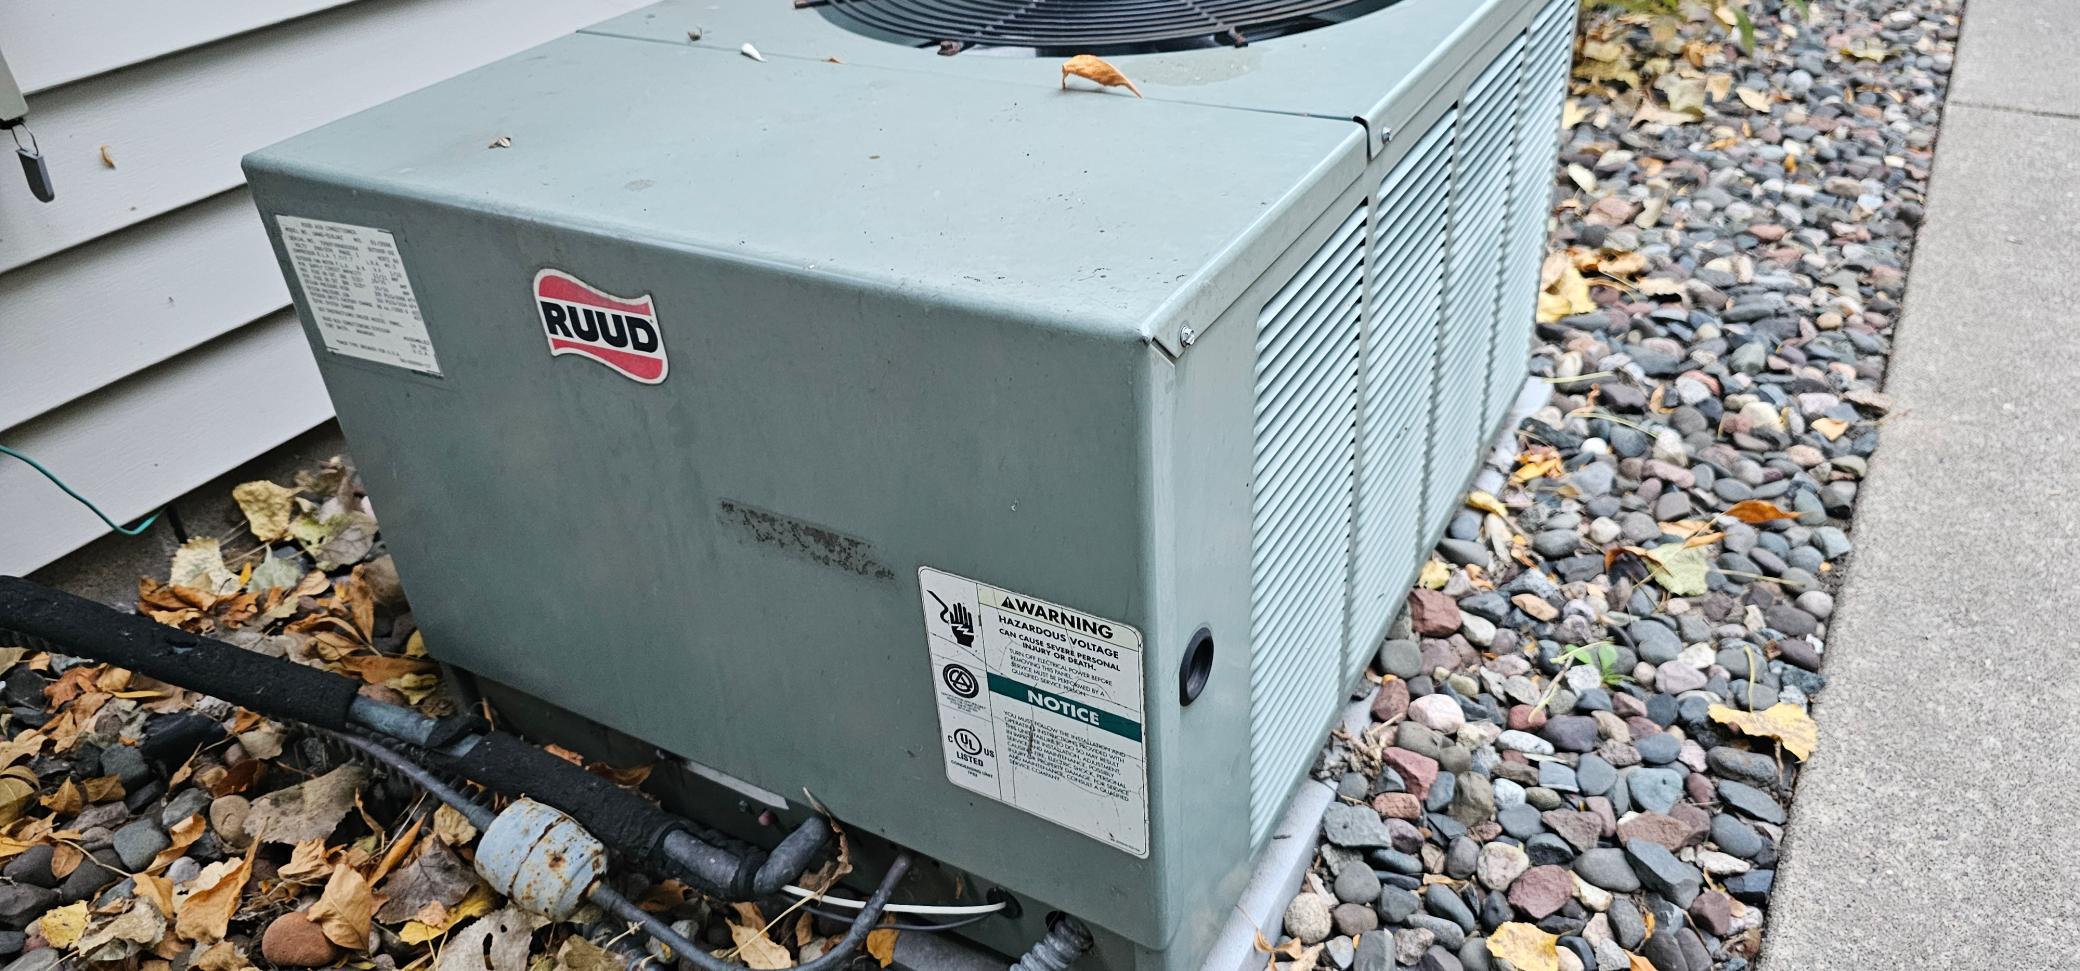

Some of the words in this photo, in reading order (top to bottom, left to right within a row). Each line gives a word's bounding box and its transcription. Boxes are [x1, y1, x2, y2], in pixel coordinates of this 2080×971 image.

[540, 301, 658, 353] RUUD
[998, 614, 1066, 643] HAZARDOUS
[1069, 636, 1118, 659] VOLTAGE
[1014, 598, 1113, 640] WARNING
[999, 627, 1016, 638] CAN
[1018, 633, 1044, 647] CAUSE
[1046, 642, 1074, 657] SEVERE
[1077, 652, 1120, 671] PERSONAL
[1009, 647, 1024, 657] TURN
[1025, 652, 1035, 661] OFF
[1037, 656, 1067, 671] ELECTRICAL
[1068, 666, 1090, 679] POWER
[1091, 674, 1112, 686] BEFORE
[1010, 654, 1040, 669] REMOVING
[1041, 664, 1053, 673] THIS
[1022, 642, 1051, 656] INJURY
[1053, 651, 1065, 661] OR
[1067, 656, 1096, 671] DEATH.
[1010, 661, 1031, 673] SERVICE
[1033, 668, 1048, 678] MUST
[1057, 676, 1090, 692] PERFORMED
[1011, 668, 1039, 681] QUALIFIED
[1040, 677, 1061, 689] SERVICE
[1027, 689, 1099, 726] NOTICE
[960, 733, 975, 751] UL
[983, 747, 994, 758] US
[1004, 710, 1016, 719] YOU
[1034, 720, 1058, 734] FOLLOW
[1059, 729, 1069, 737] THE
[1070, 733, 1110, 752] INSTALLATION
[1111, 747, 1125, 758] AND
[1005, 722, 1016, 731] THIS
[1064, 743, 1074, 752] DO
[1075, 747, 1084, 755] SO
[1085, 751, 1098, 760] MAY
[1099, 755, 1119, 768] RESULT
[1037, 728, 1077, 747] INSTRUCTIONS
[1079, 742, 1107, 757] PROVIDED
[1108, 753, 1124, 764] WITH
[956, 750, 983, 767] LISTED
[1006, 734, 1027, 746] SERVICE
[1088, 764, 1114, 778] POSSIBLY
[1047, 755, 1071, 768] ELECTRIC
[1096, 773, 1126, 788] PERSONAL
[1037, 757, 1063, 771] PROPERTY
[1093, 778, 1105, 787] FOR
[1106, 782, 1128, 795] SERVICE
[1066, 774, 1092, 788] CONSULT
[1099, 786, 1128, 802] QUALIFIED
